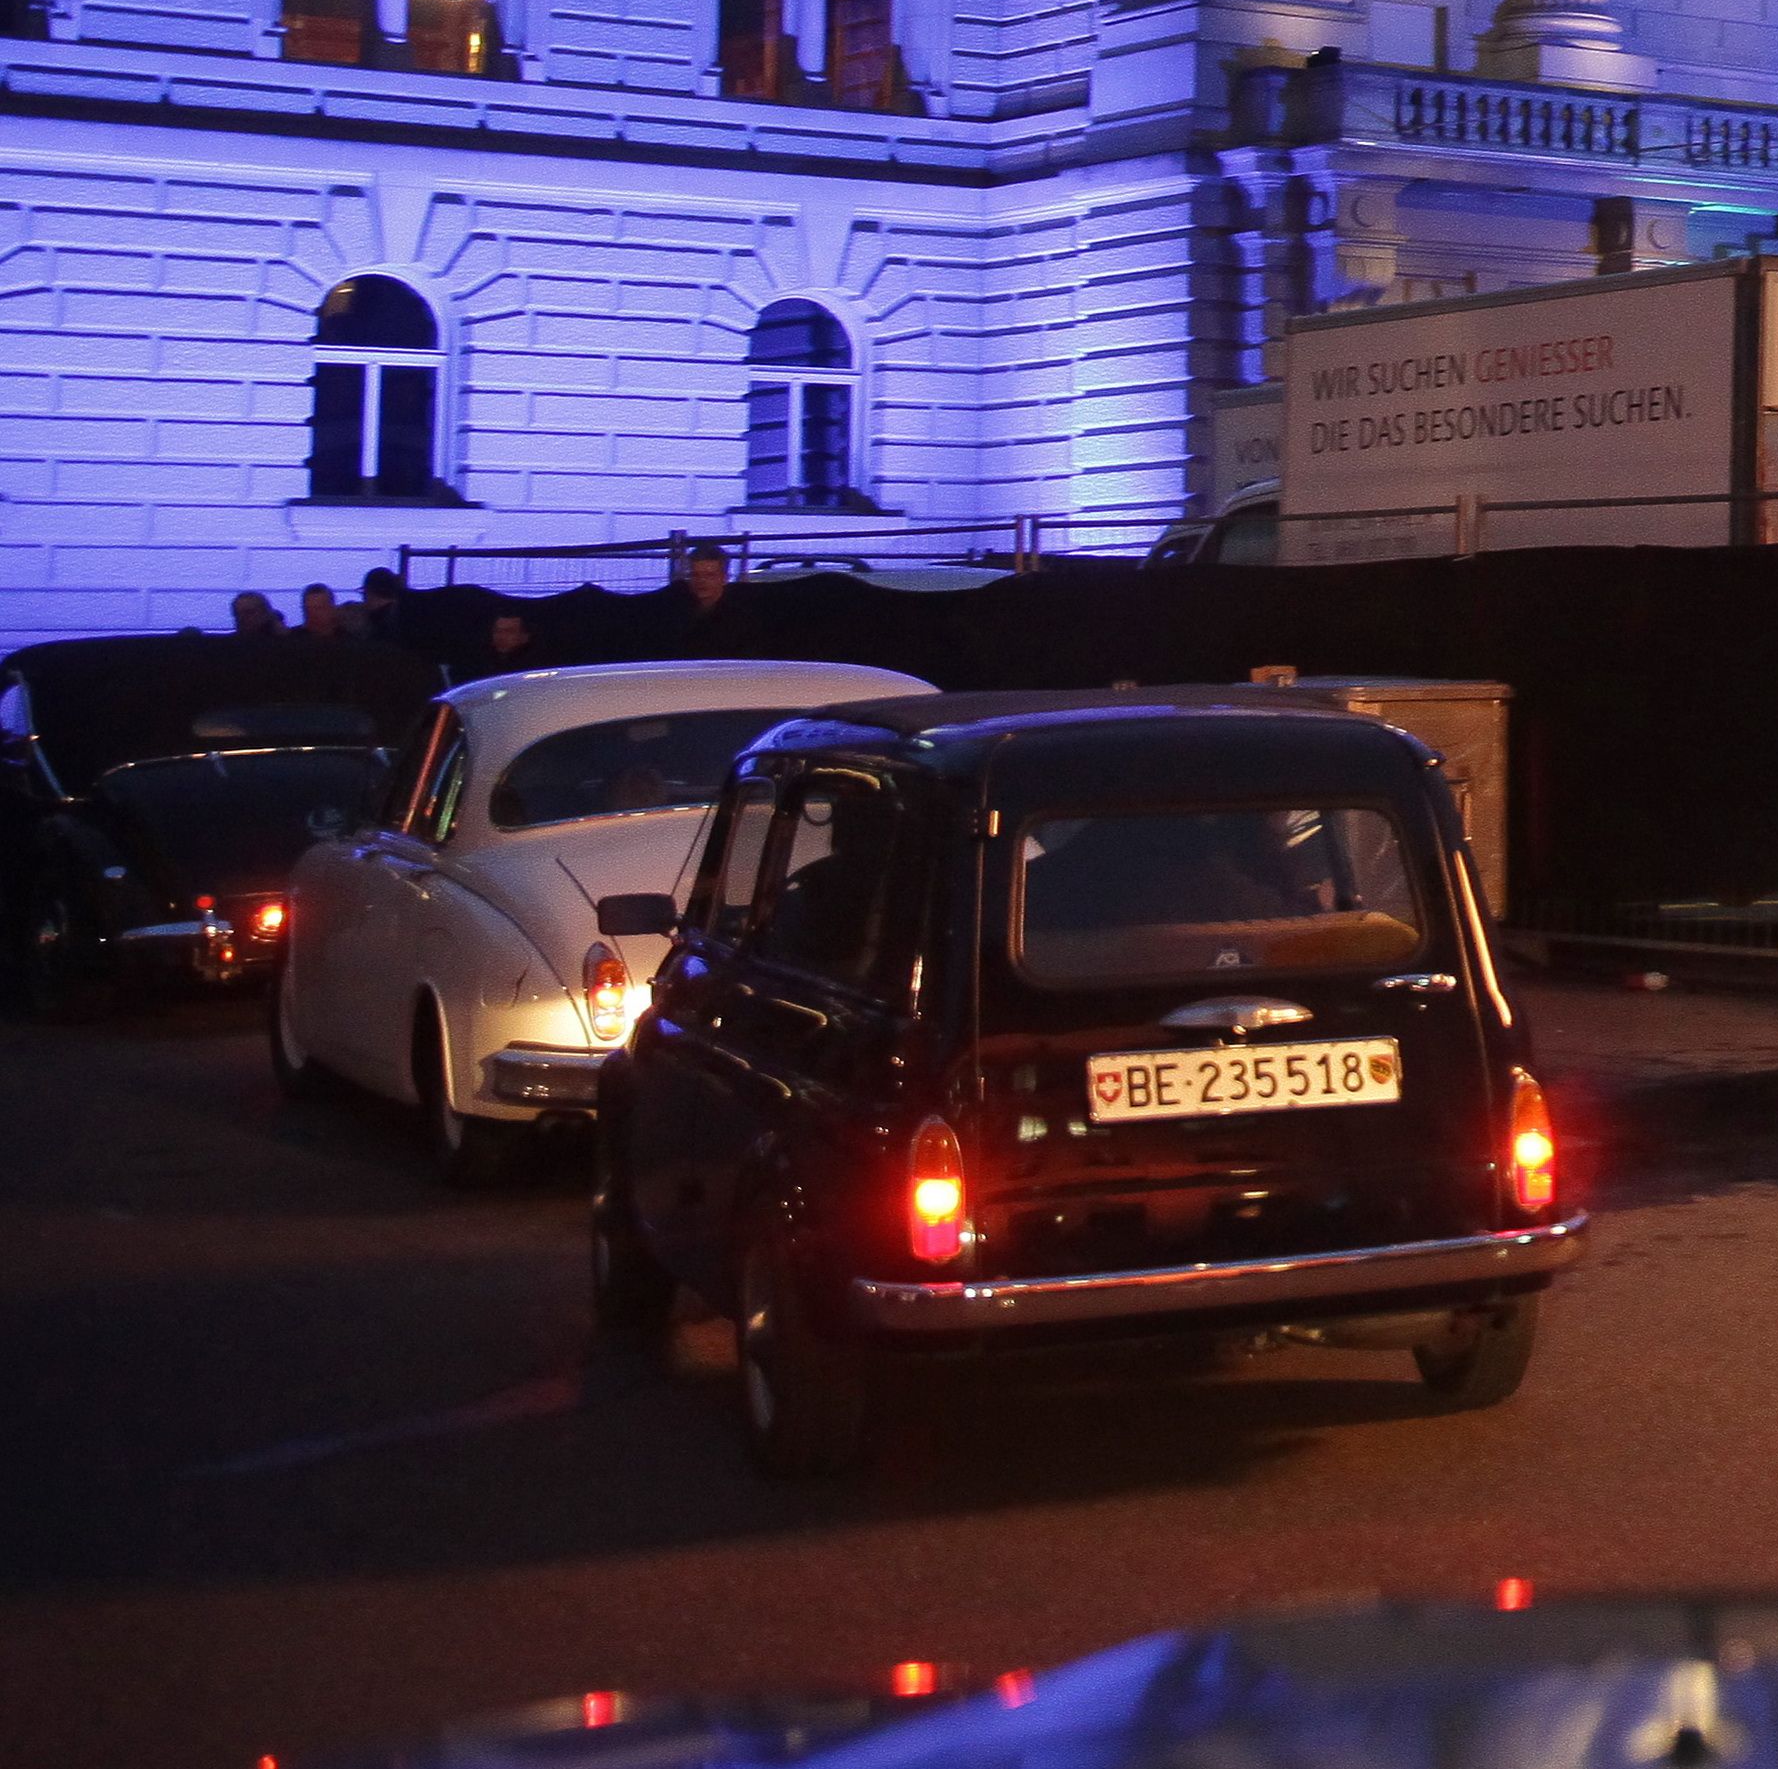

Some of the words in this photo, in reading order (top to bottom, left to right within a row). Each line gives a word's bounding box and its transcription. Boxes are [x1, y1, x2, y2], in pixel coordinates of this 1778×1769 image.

[1311, 364, 1361, 402] WIR
[1366, 353, 1468, 396] SUCHEN
[1473, 334, 1616, 384] GENIESSER
[1310, 419, 1352, 455] DIE
[1358, 412, 1405, 451] DAS
[1413, 395, 1568, 445] BESONDERE
[1571, 383, 1694, 430] SUCHEN.
